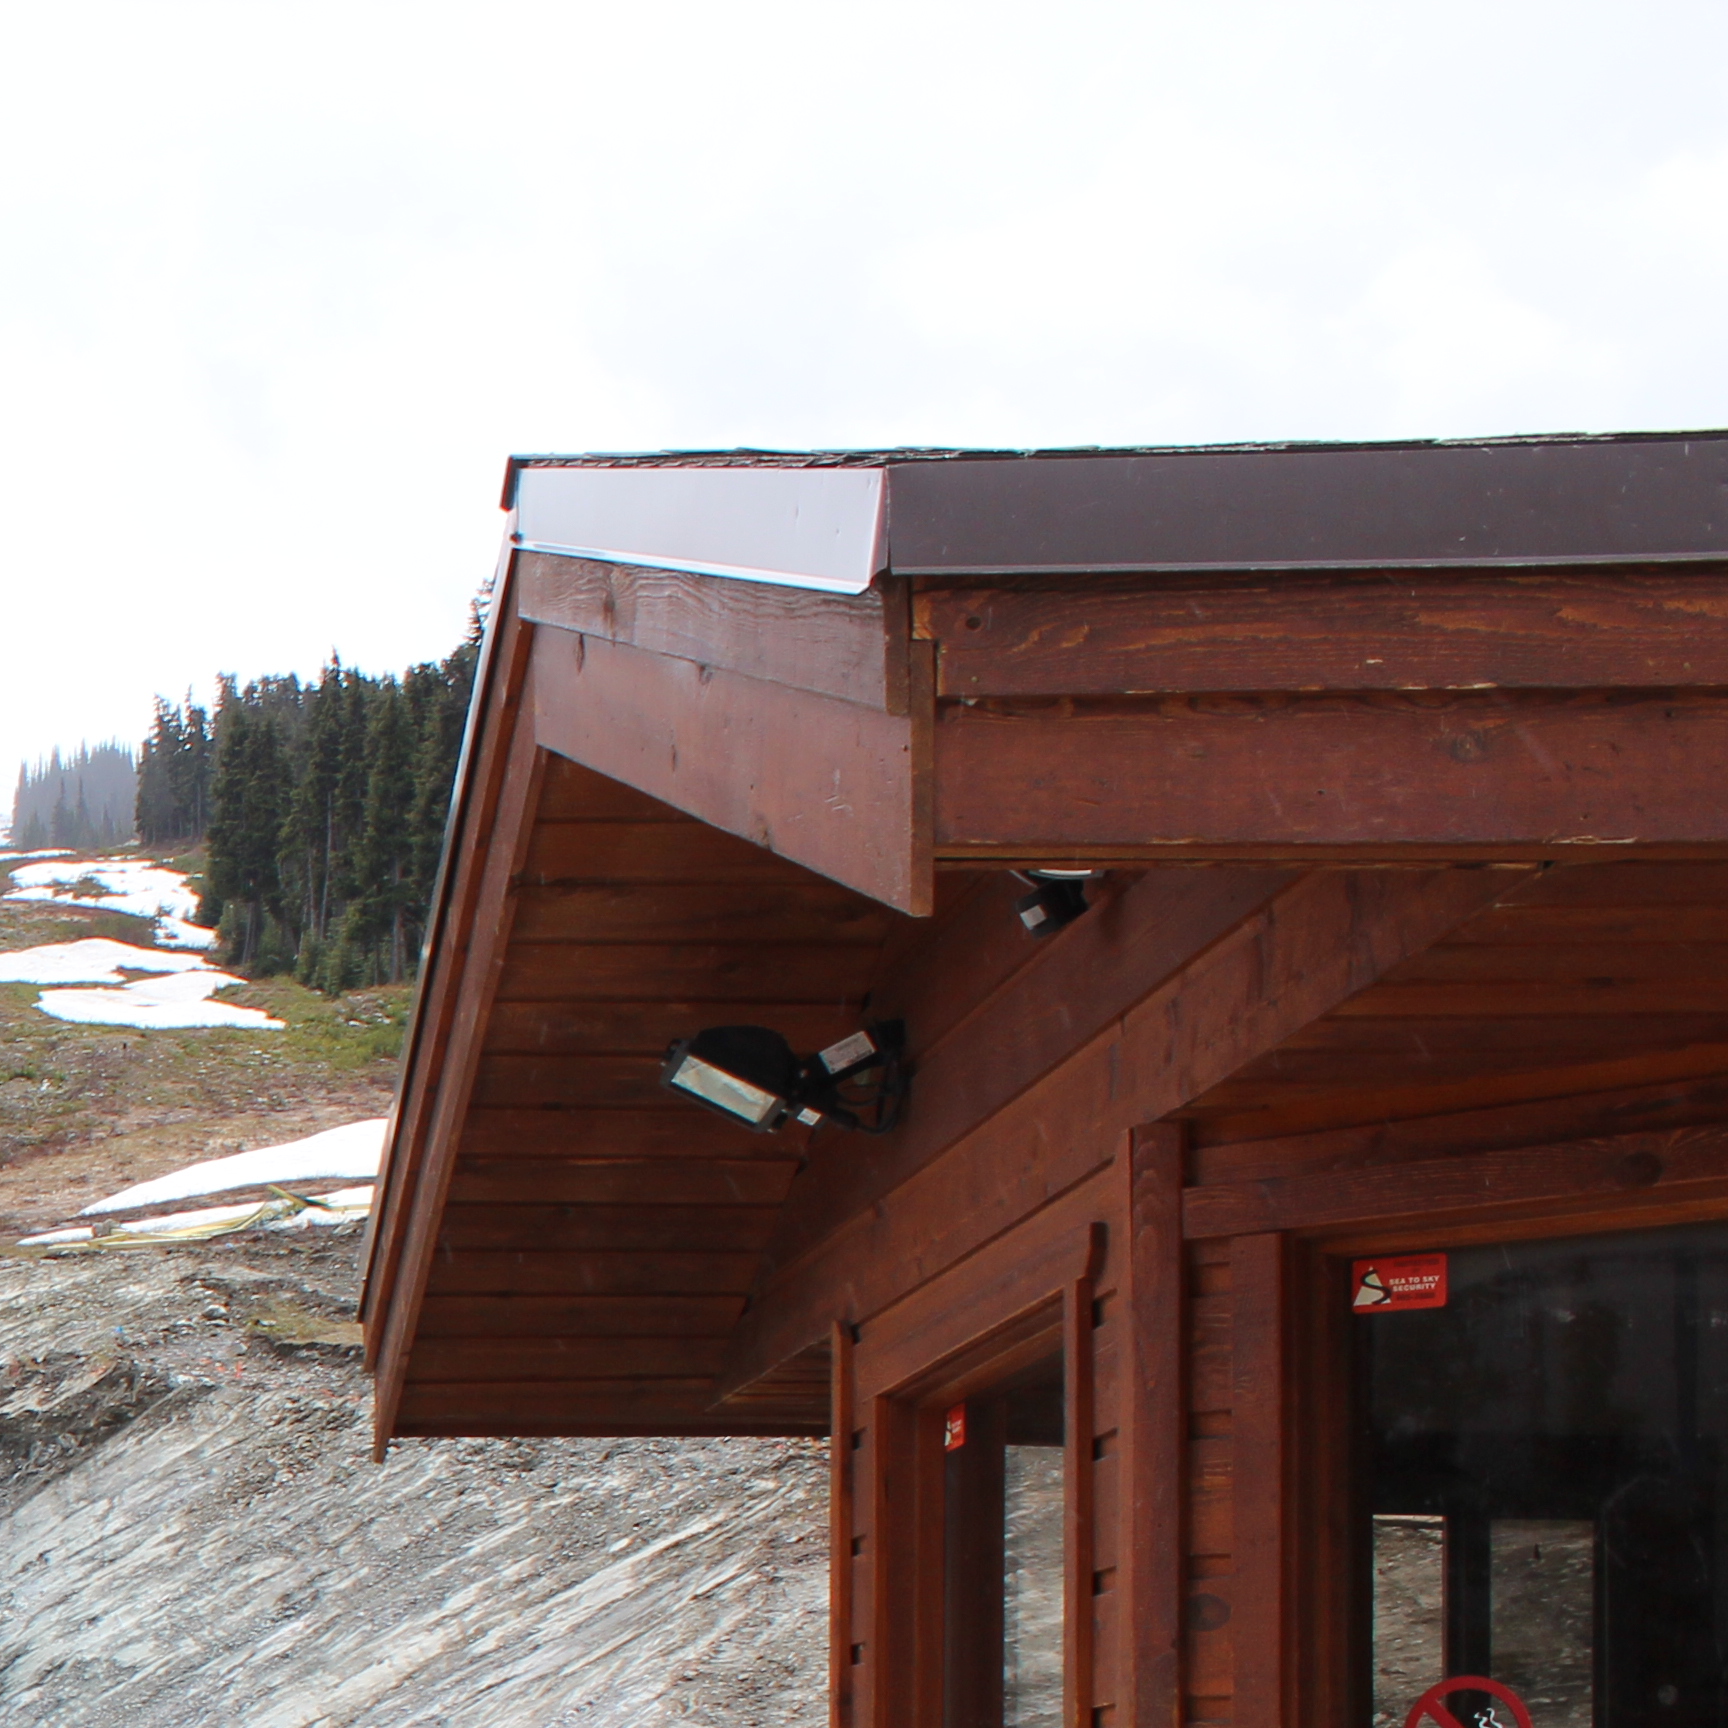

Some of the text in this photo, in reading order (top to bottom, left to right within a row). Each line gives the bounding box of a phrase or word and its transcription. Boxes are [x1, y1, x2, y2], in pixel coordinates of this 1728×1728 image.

[1389, 1275, 1440, 1286] SEA TO SKY
[1392, 1283, 1436, 1292] SECURITY
